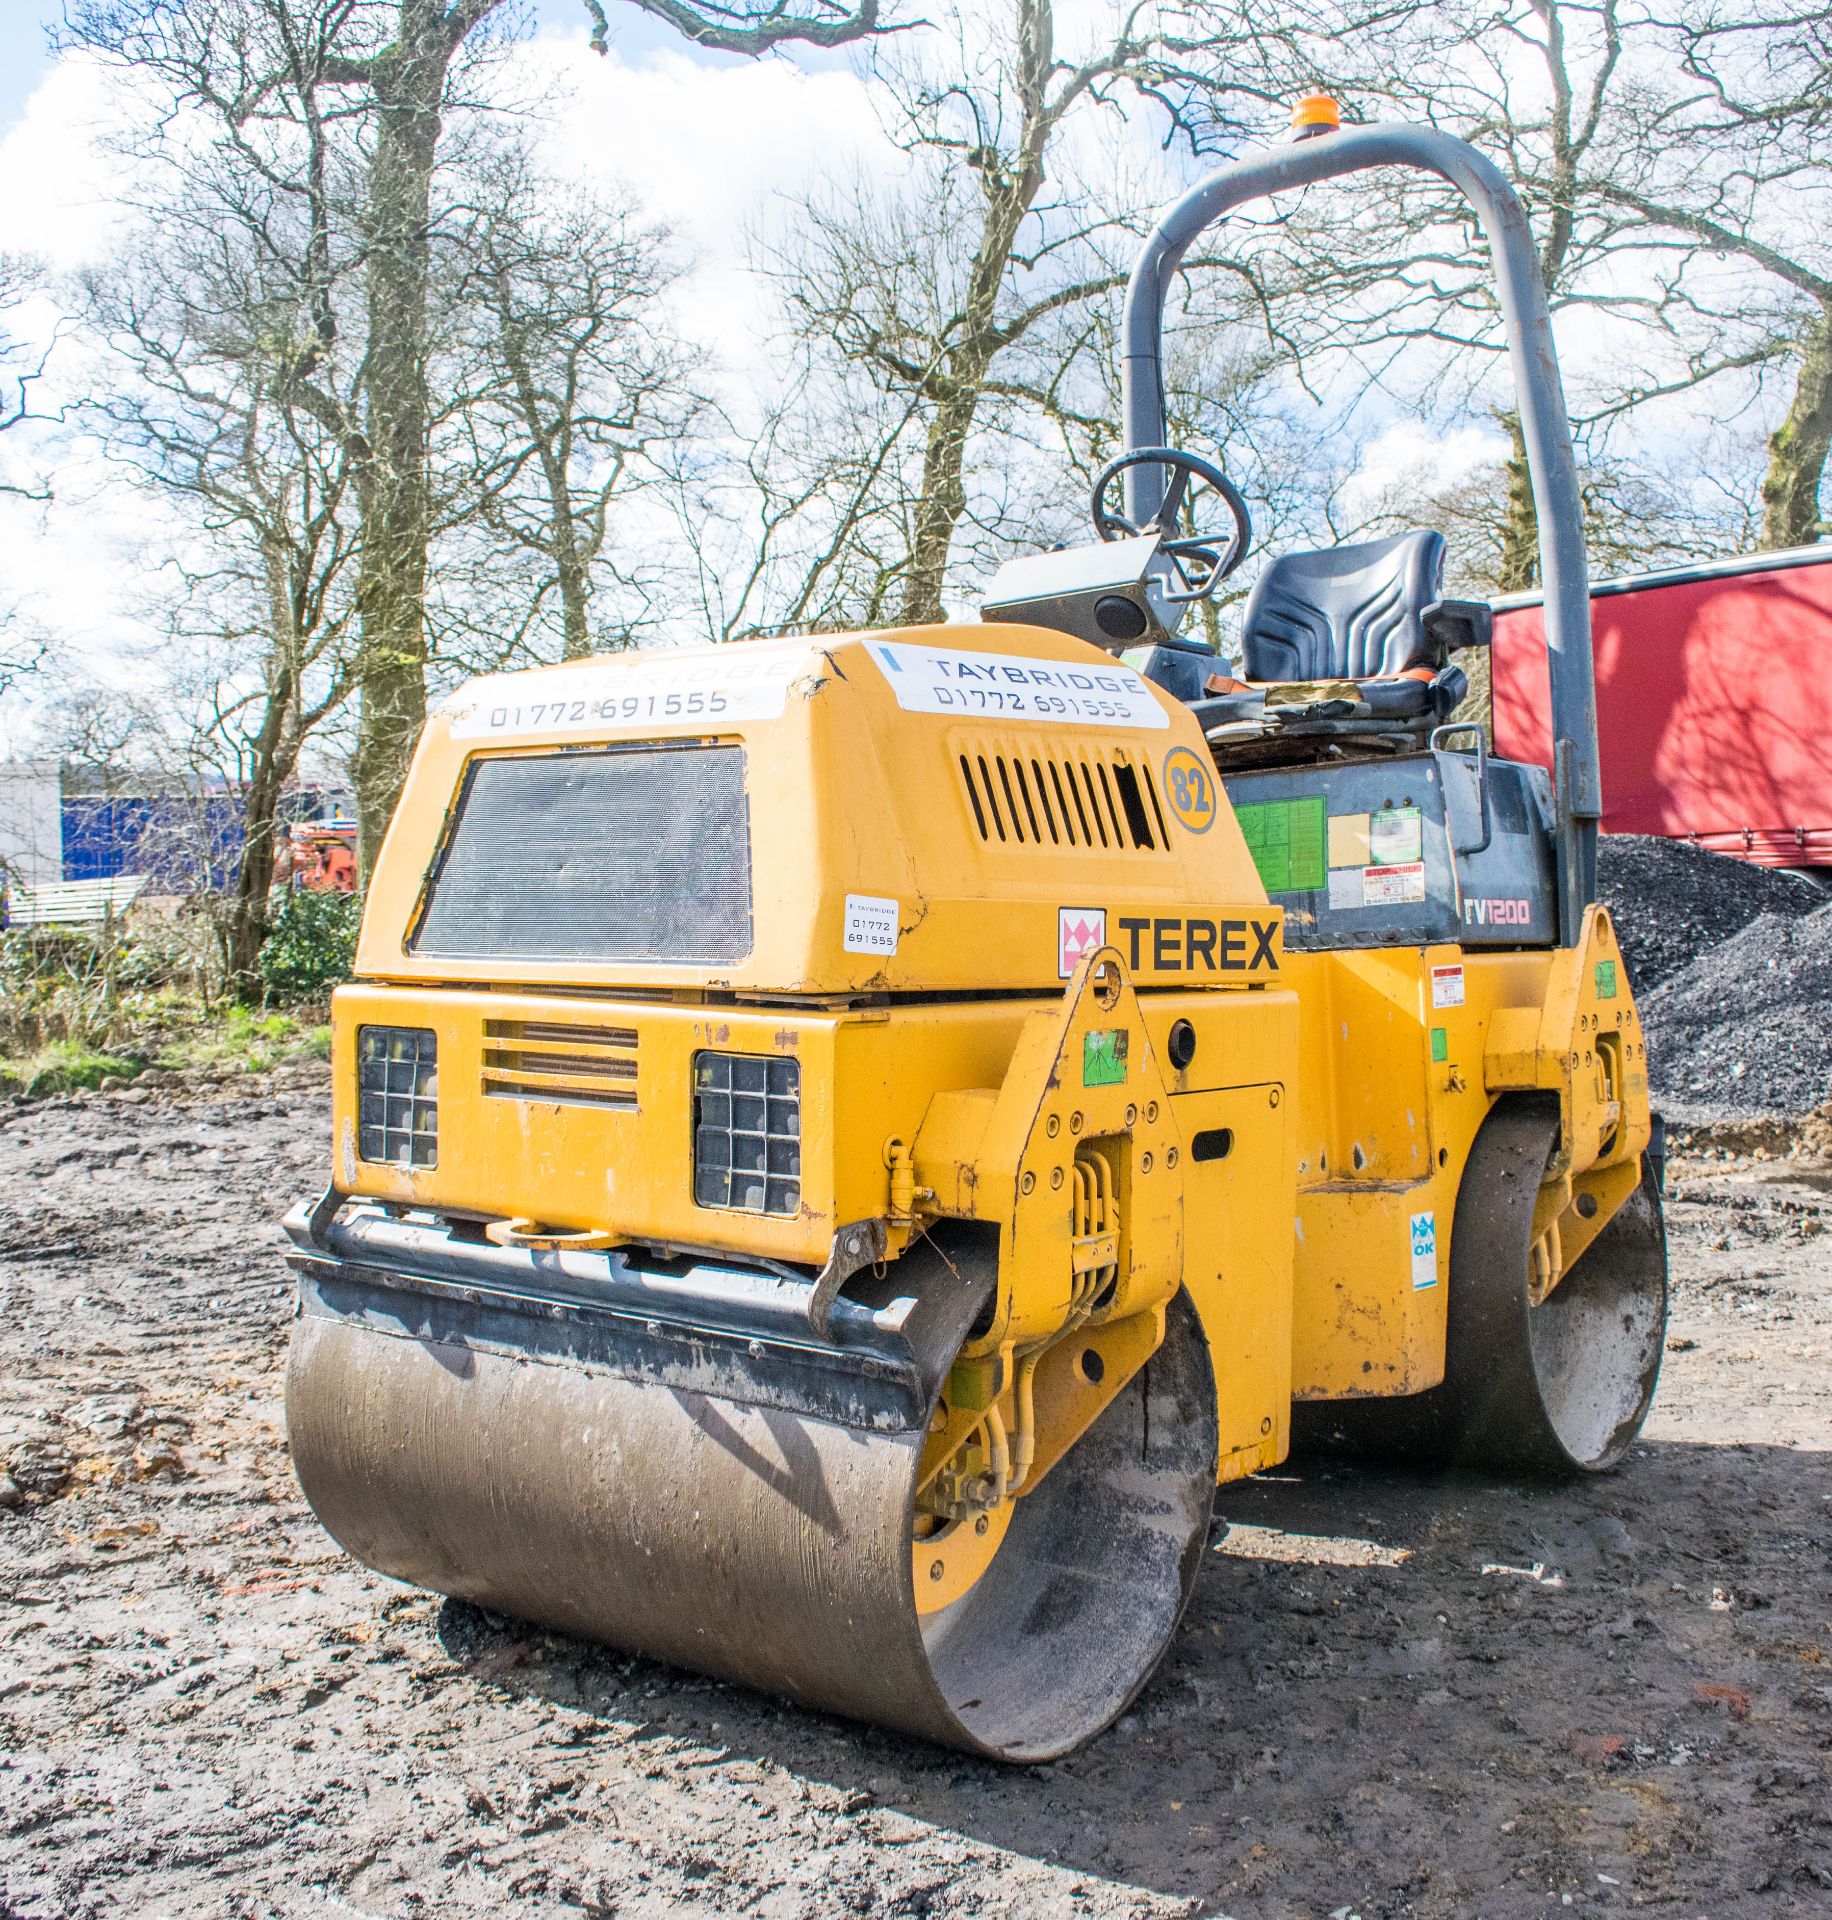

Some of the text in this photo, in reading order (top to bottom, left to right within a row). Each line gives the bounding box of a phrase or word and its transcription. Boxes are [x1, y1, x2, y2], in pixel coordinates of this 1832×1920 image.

[928, 659, 1146, 695] TAYBRIDGE
[490, 691, 728, 728] 01772 691555
[933, 687, 1132, 719] 01772 691555
[1170, 767, 1210, 812] 82
[857, 905, 897, 915] TAYBRIDGE
[1464, 898, 1531, 925] TV1200
[848, 933, 894, 946] 691555
[852, 919, 890, 931] 01772
[1118, 917, 1280, 971] TEREX
[1413, 1242, 1434, 1257] OK
